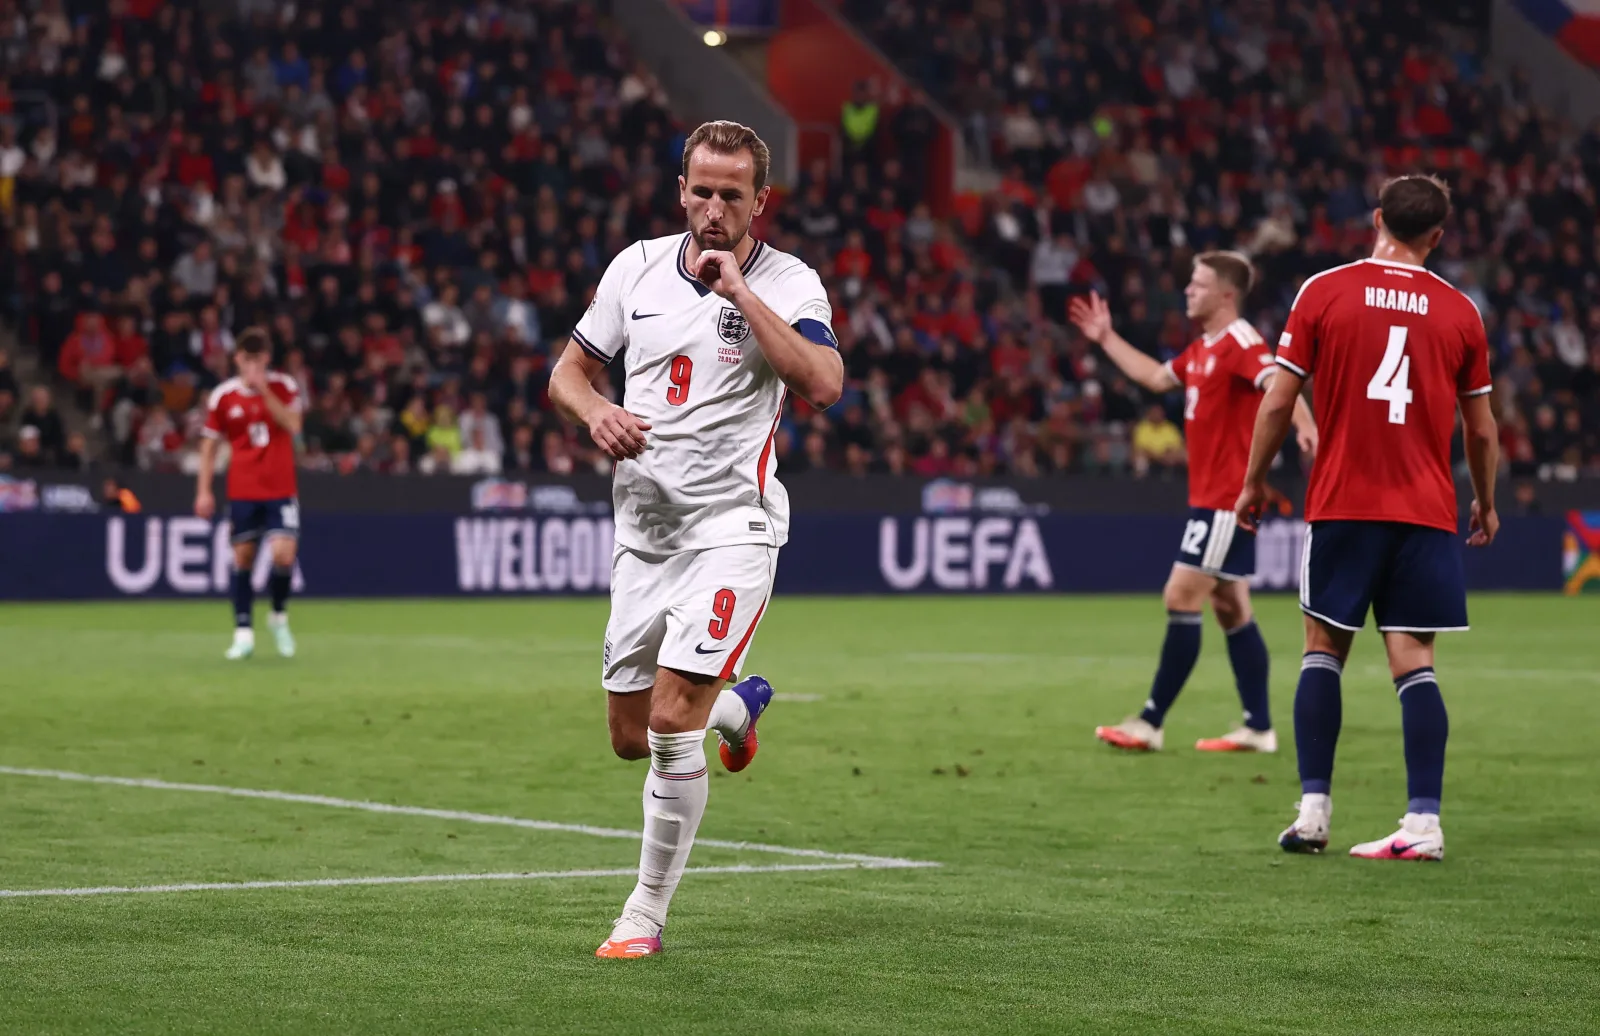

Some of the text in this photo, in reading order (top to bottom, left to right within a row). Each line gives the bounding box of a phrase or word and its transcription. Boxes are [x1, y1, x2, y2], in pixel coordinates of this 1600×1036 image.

[717, 347, 741, 356] CZECHIA
[1367, 325, 1413, 425] 4
[666, 354, 693, 407] 9
[879, 516, 1054, 591] UEFA
[1180, 518, 1208, 556] 12
[707, 588, 737, 641] 9
